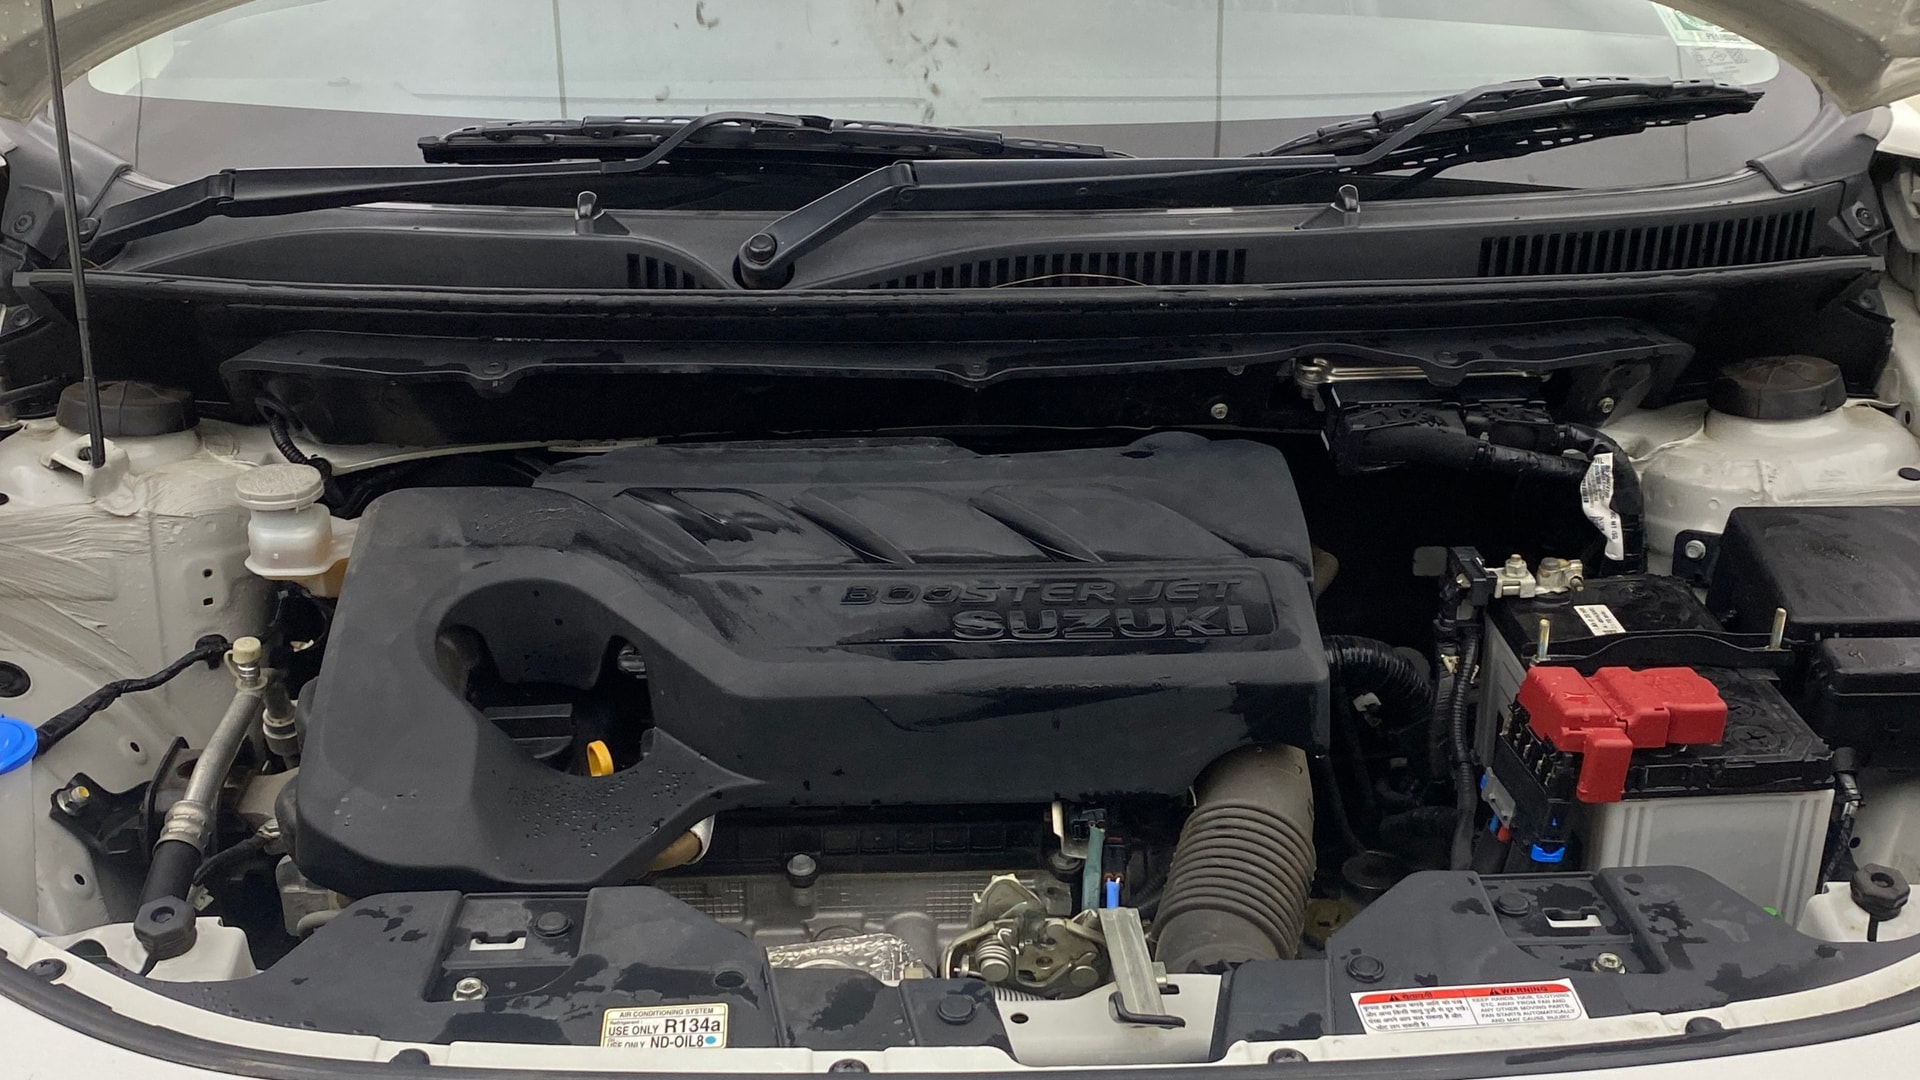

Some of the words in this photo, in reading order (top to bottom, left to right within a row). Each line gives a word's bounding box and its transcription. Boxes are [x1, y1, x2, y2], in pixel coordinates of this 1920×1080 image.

[840, 582, 1115, 606] BOOSTER
[1128, 579, 1241, 602] JET
[952, 605, 1249, 640] SUZUKI
[1500, 986, 1548, 994] WARNING
[633, 1009, 684, 1017] CONDITIONING
[608, 1025, 629, 1036] USE
[632, 1024, 659, 1035] ONLY
[664, 1018, 720, 1034] R134a
[650, 1035, 704, 1048] ND-OIL8
